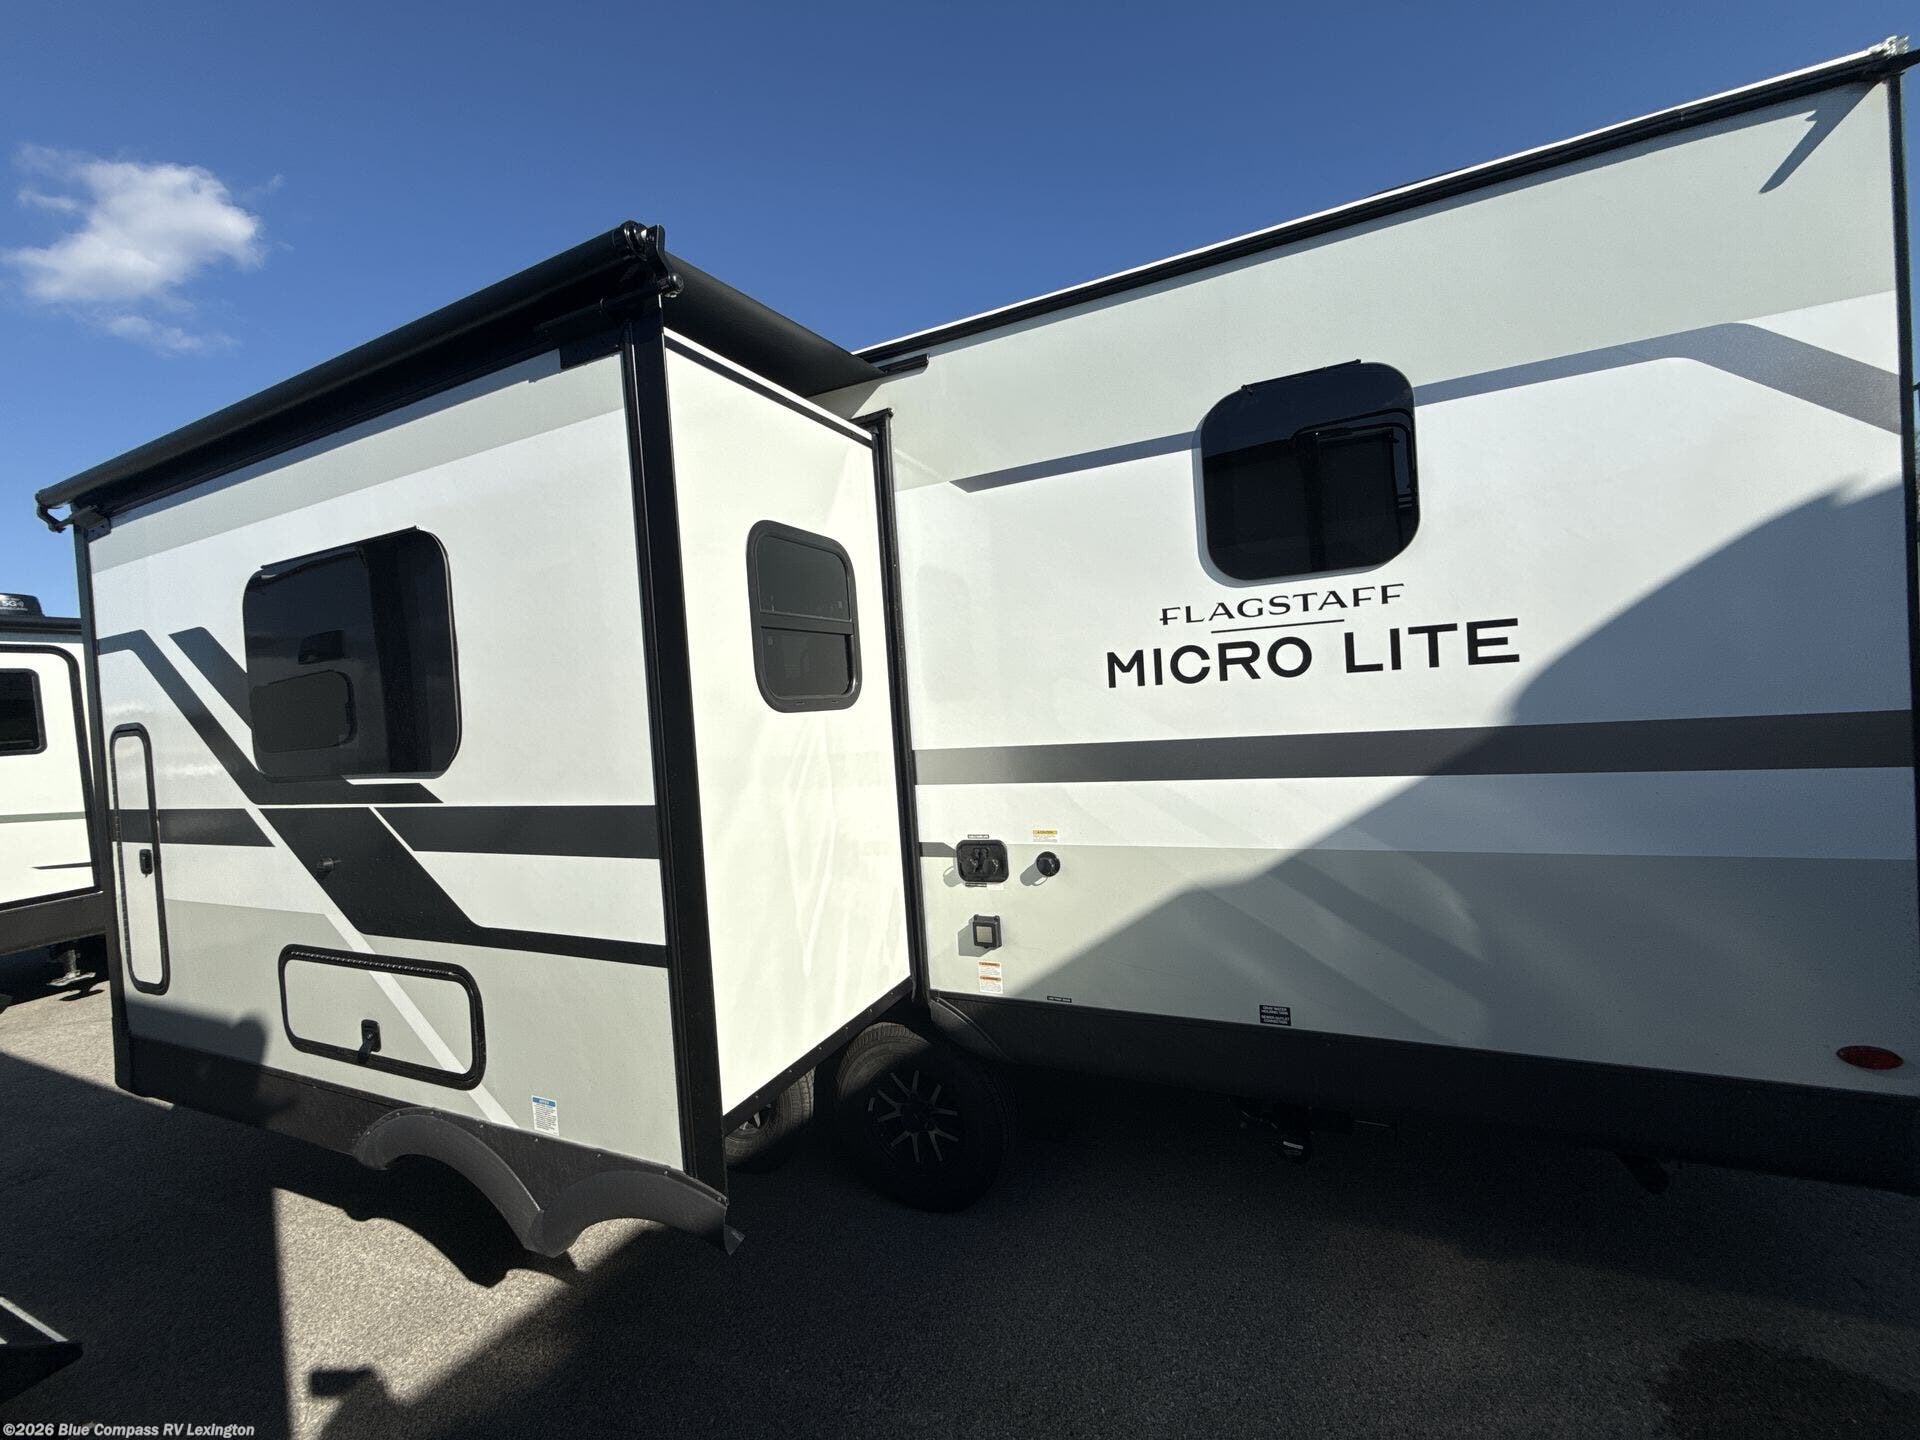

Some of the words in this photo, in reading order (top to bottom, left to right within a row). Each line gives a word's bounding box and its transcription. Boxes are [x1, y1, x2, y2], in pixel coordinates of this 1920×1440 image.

[1159, 583, 1405, 625] FLAGSTAFF
[1107, 636, 1312, 688] MICRO
[1344, 617, 1520, 673] LITE
